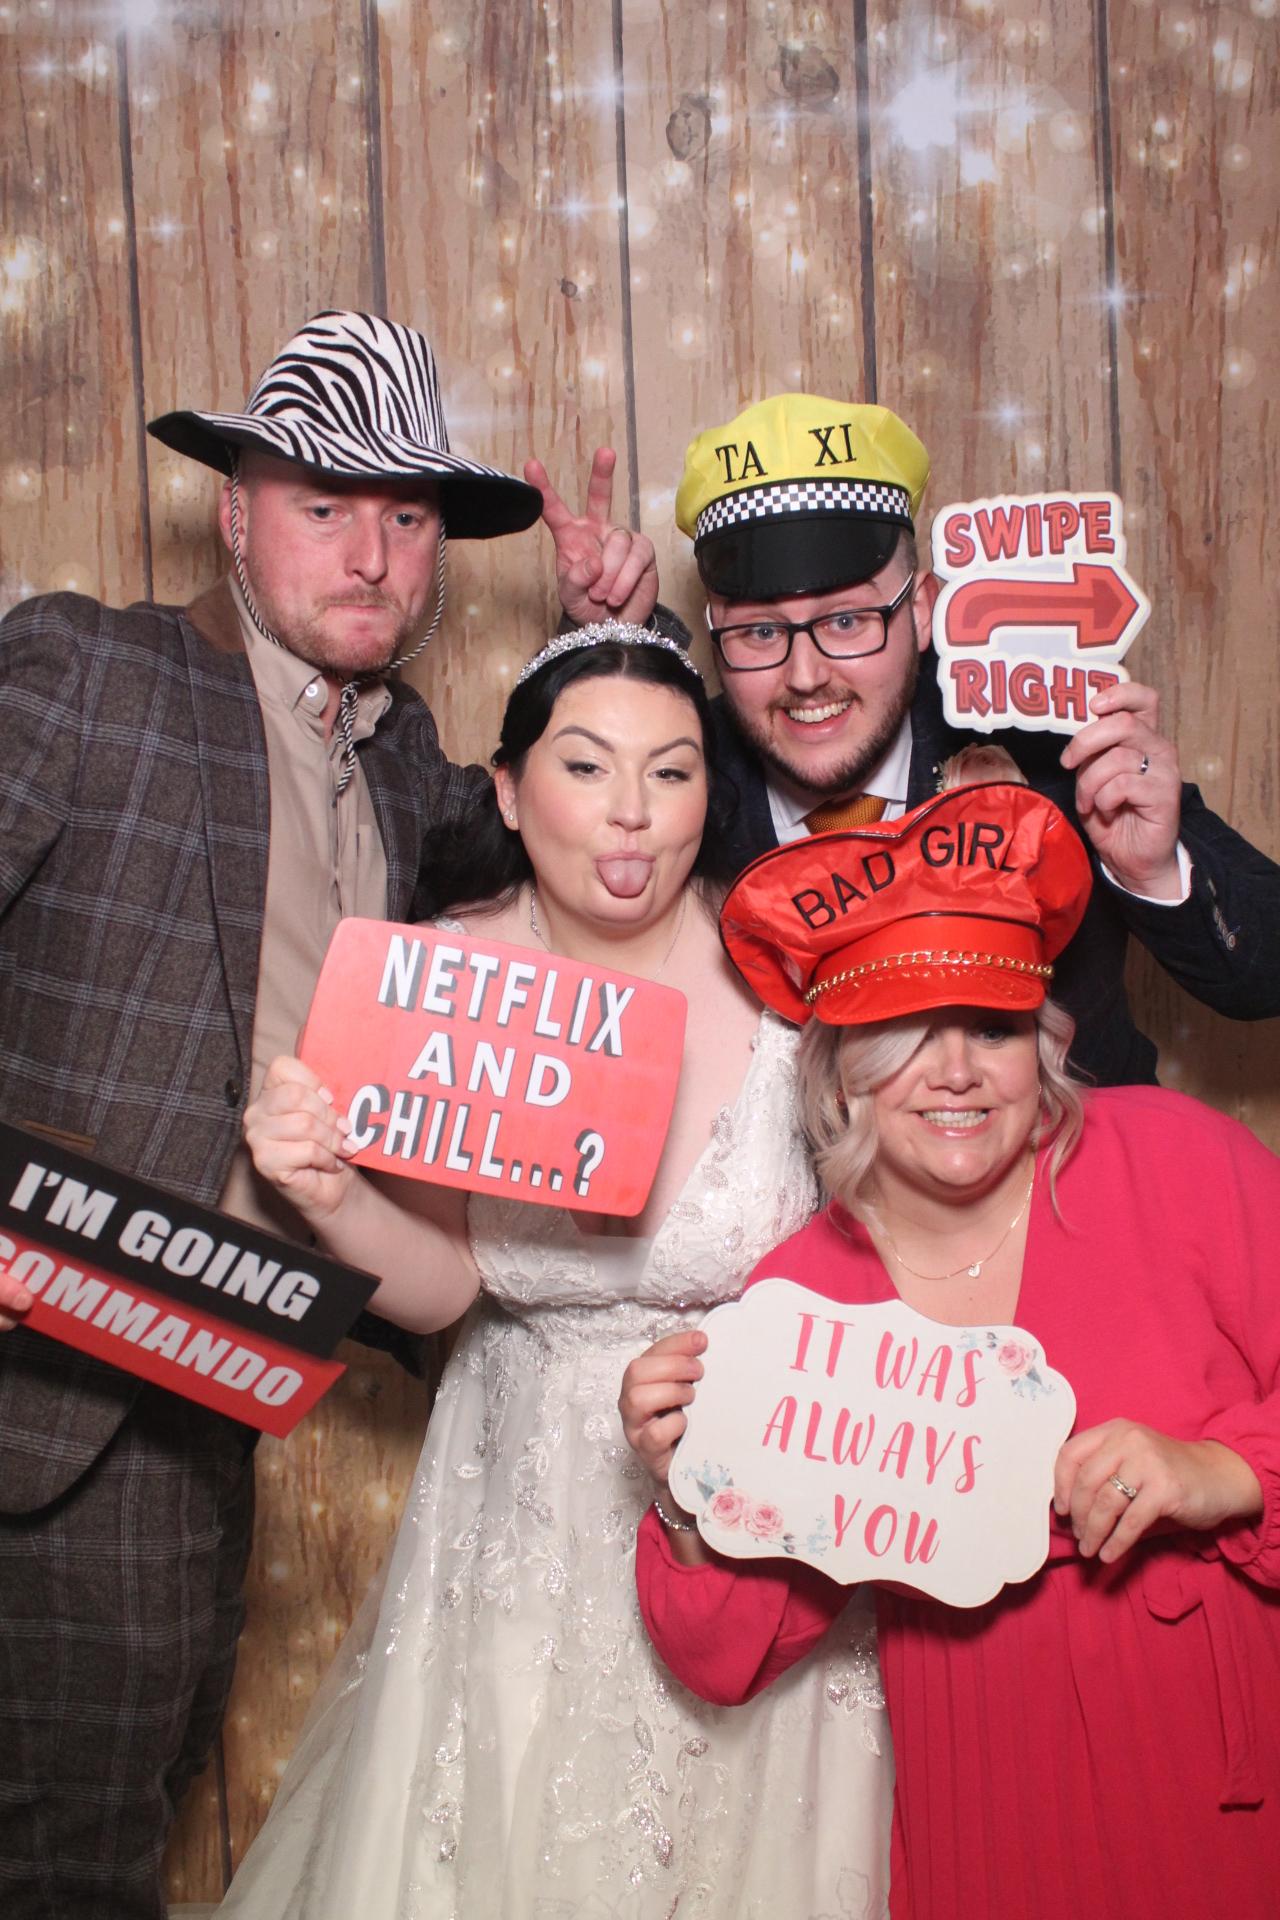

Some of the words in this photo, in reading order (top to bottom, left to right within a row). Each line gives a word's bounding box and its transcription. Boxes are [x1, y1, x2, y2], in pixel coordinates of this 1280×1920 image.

[943, 500, 1116, 568] SWIPE
[790, 851, 897, 931] BAD
[919, 822, 1018, 873] GIRL
[377, 933, 636, 1057] NETFLIX
[407, 1031, 573, 1108] AND
[8, 1161, 119, 1241] I'M
[117, 1209, 322, 1323] GOING
[788, 1311, 856, 1379] IT
[873, 1330, 987, 1409] WAS
[761, 1395, 986, 1494] ALWAYS
[833, 1493, 941, 1565] YOU
